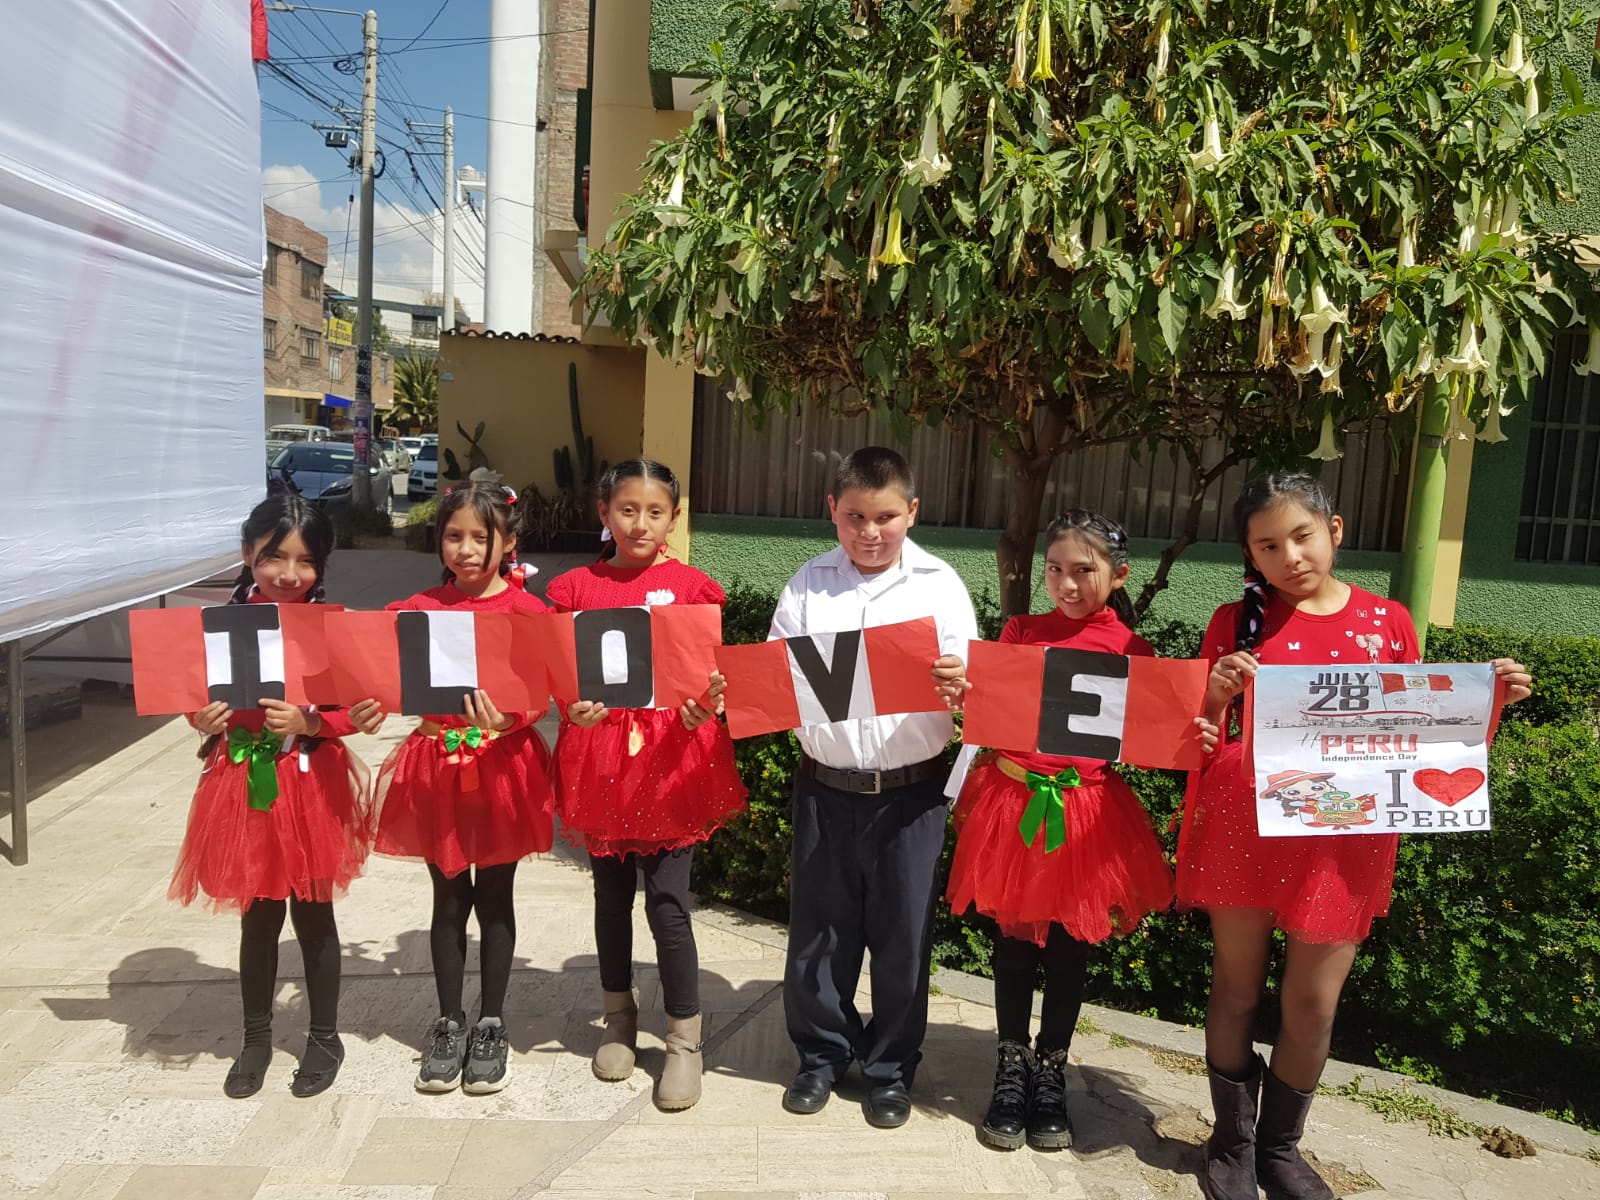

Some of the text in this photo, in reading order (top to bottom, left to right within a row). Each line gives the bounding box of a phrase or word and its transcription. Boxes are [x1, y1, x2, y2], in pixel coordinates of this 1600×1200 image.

[1309, 672, 1370, 686] JULY
[1320, 734, 1418, 755] PERU
[1321, 753, 1418, 762] Independence Day
[1385, 769, 1408, 808] I
[1386, 810, 1488, 828] PERU
